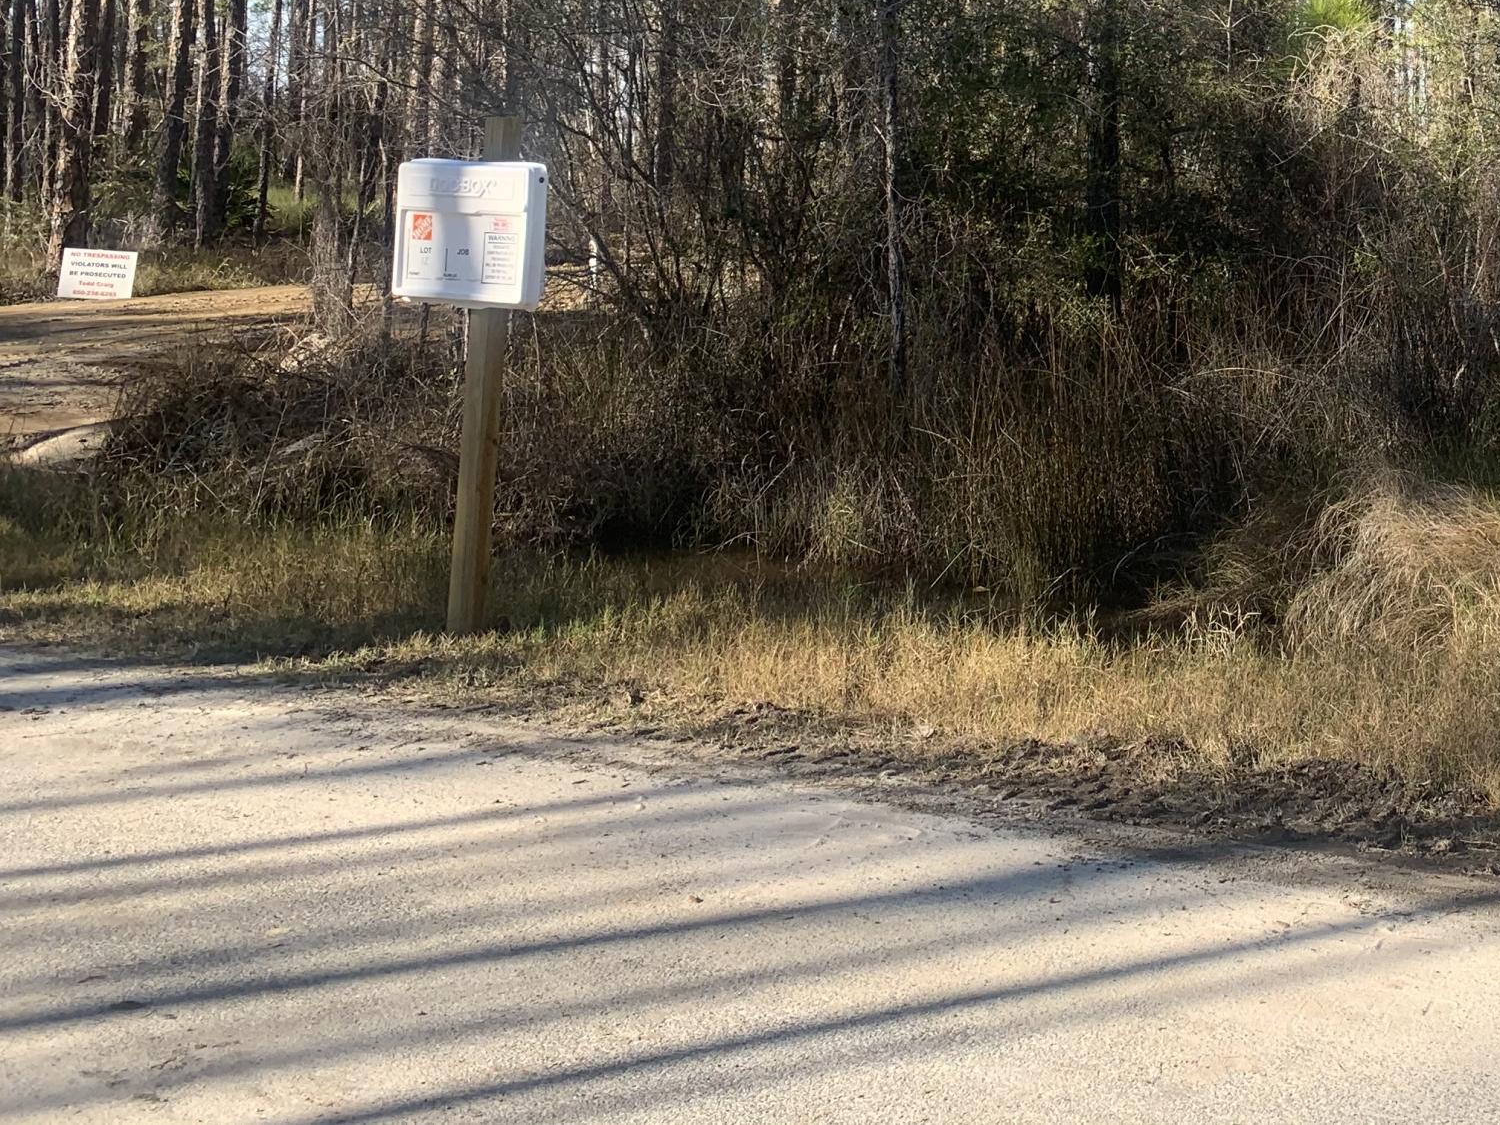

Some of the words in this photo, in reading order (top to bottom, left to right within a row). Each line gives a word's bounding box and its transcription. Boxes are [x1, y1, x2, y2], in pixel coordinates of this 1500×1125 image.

[83, 252, 131, 260] TRESPASSING
[456, 248, 470, 256] JOB
[80, 271, 127, 279] PROSECUTED
